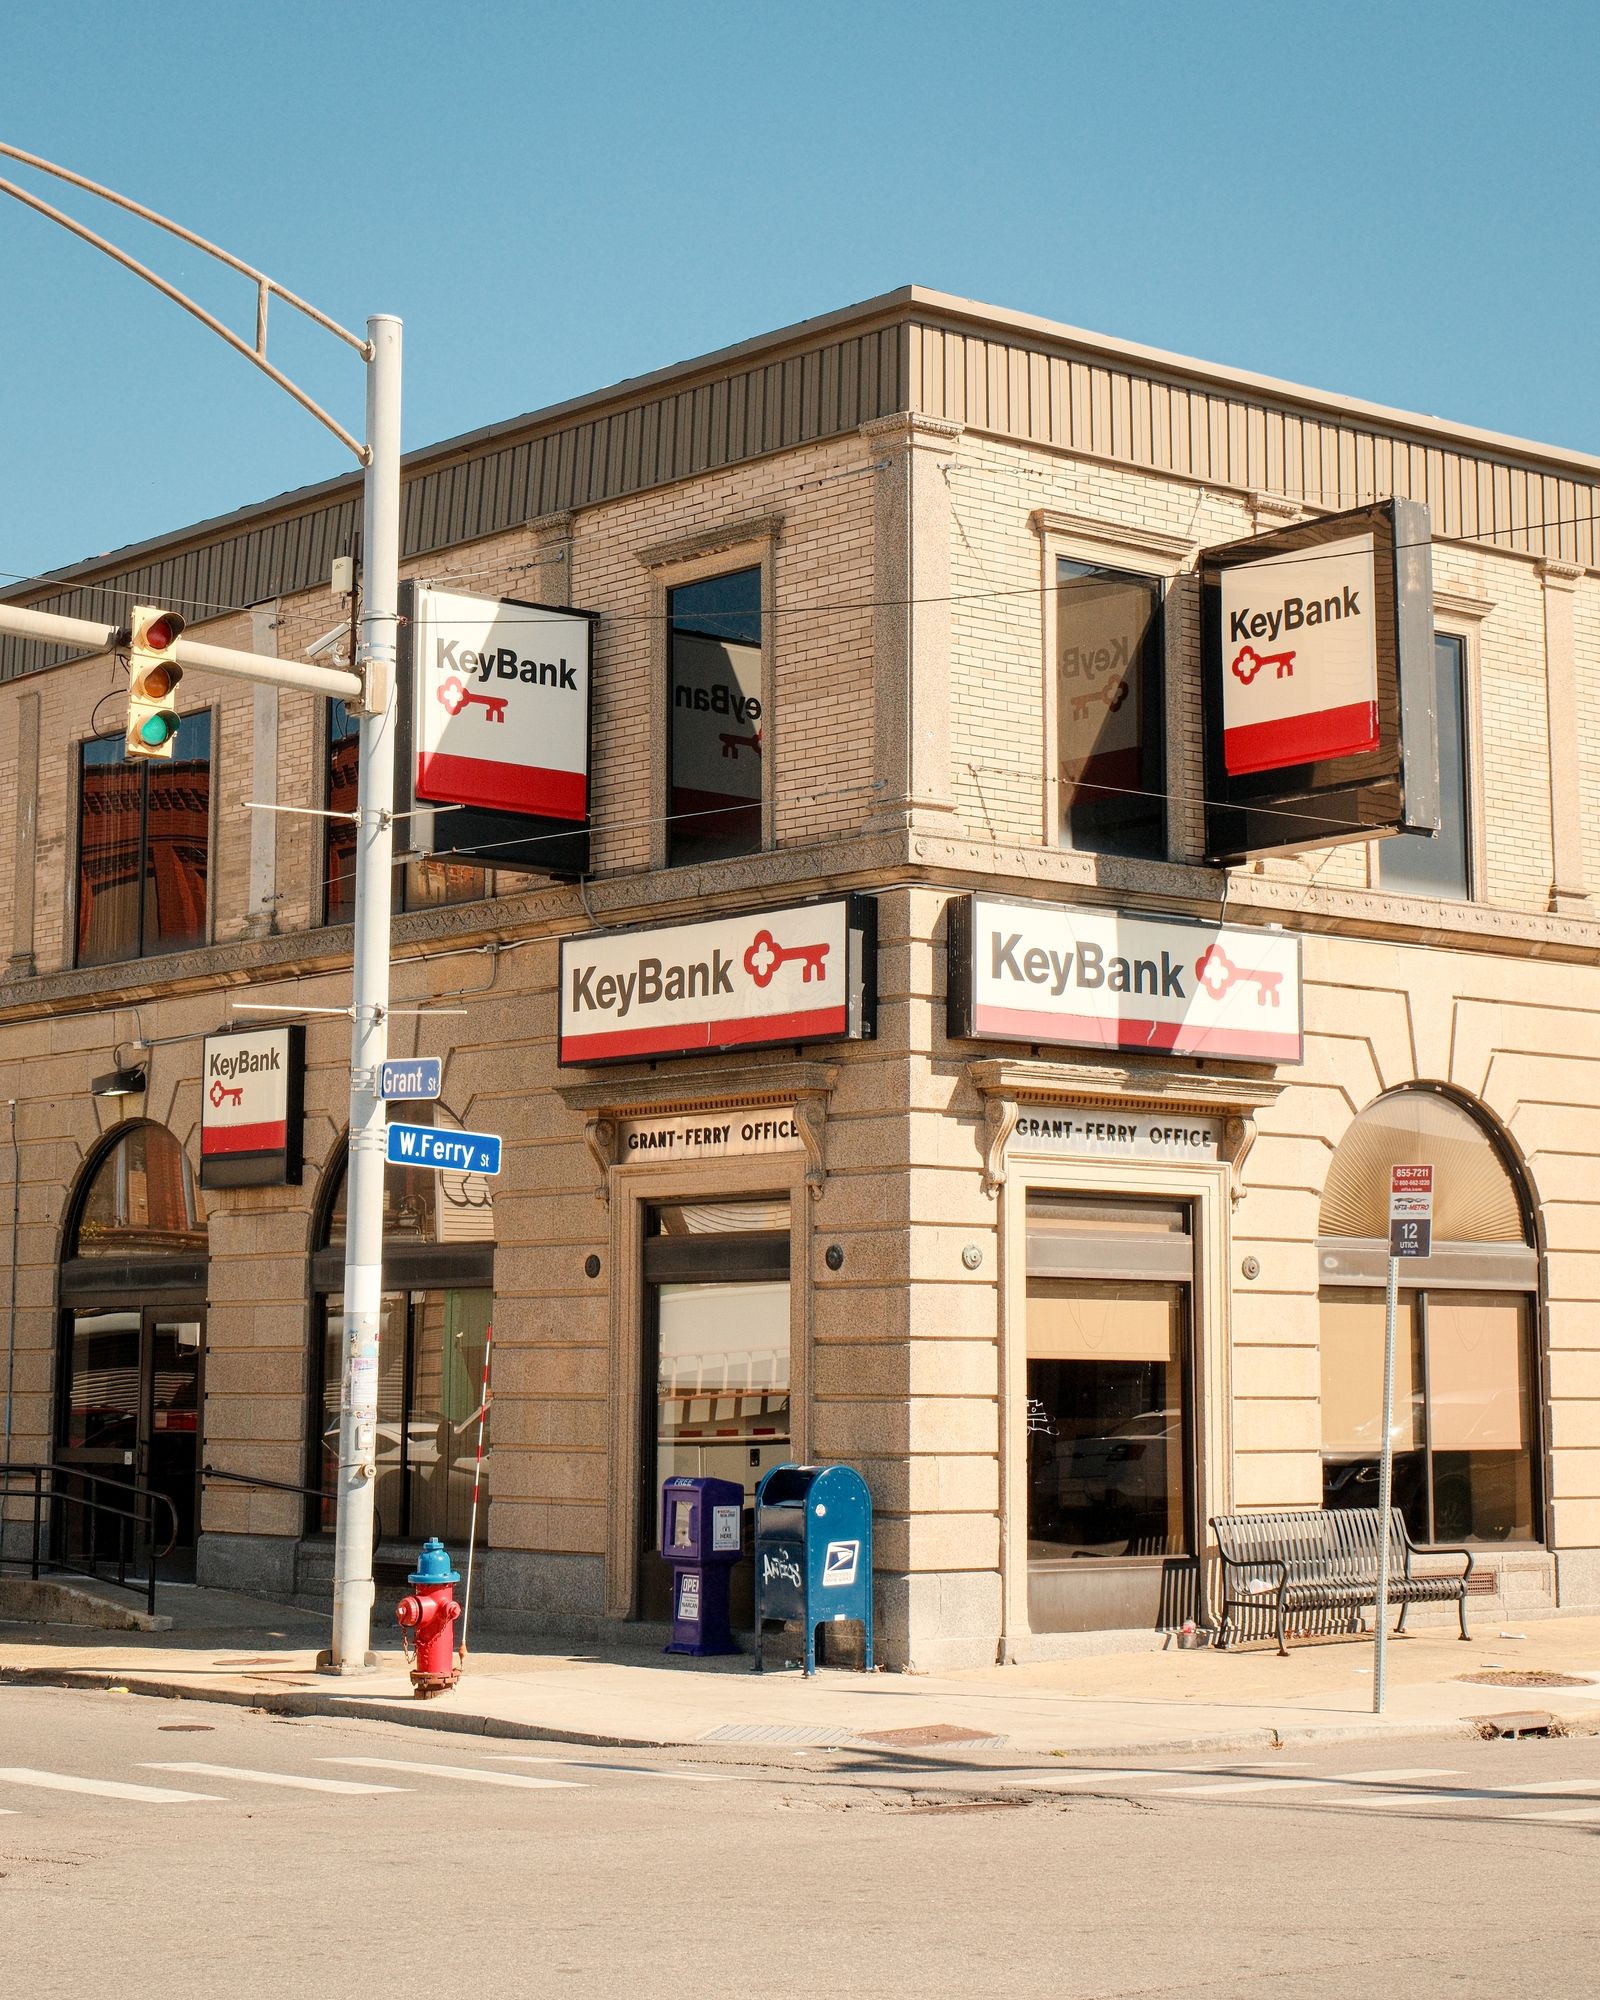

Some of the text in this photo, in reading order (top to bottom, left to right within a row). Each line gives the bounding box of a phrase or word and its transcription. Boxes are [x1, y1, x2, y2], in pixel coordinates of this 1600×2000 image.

[1230, 585, 1361, 642] KeyBank
[436, 637, 577, 691] KeyBank
[991, 931, 1186, 999] KeyBank
[572, 948, 735, 1018] KeyBank
[210, 1047, 281, 1080] KeyBank
[383, 1066, 437, 1094] Grant St
[628, 1124, 731, 1150] GRANT-FERRY
[1015, 1118, 1212, 1148] GRANT-FERRY OFFICE
[400, 1131, 490, 1169] W.Ferry St
[1396, 1168, 1429, 1178] 855-7211
[1400, 1241, 1419, 1249] UTICA
[1402, 1222, 1418, 1239] 12
[673, 1479, 695, 1487] FREE
